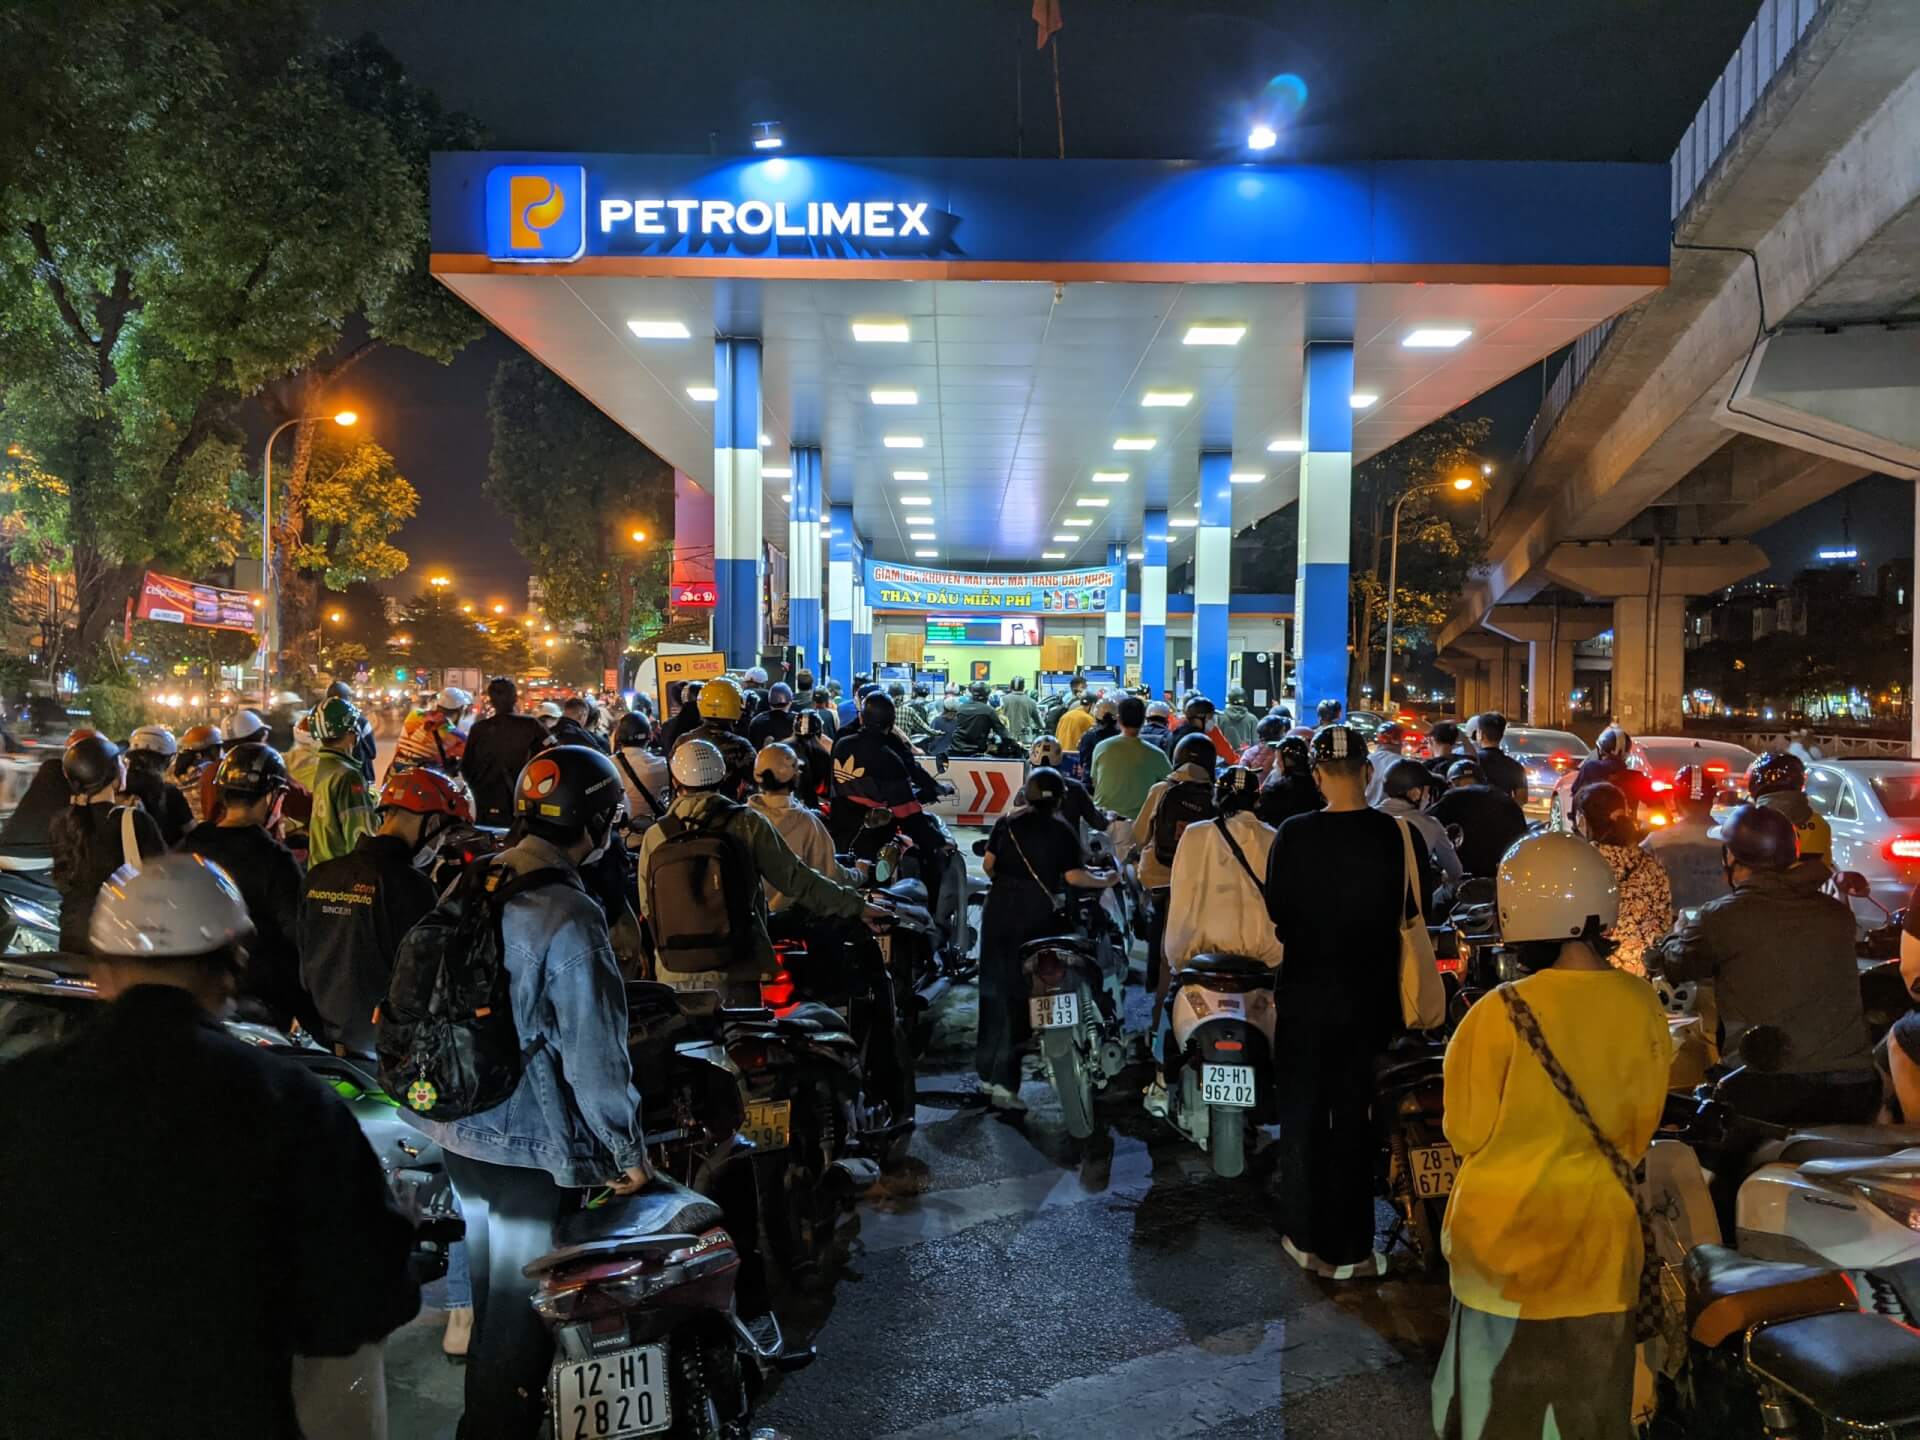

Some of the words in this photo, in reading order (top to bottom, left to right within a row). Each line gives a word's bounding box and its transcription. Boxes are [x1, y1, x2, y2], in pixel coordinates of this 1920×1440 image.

[599, 199, 930, 237] PETROLIMEX
[880, 590, 922, 603] THAY
[1005, 591, 1032, 607] PHÍ
[664, 661, 682, 672] be
[1209, 1067, 1248, 1084] 29-H1
[1205, 1085, 1253, 1103] 962.02
[1419, 1172, 1454, 1194] 673
[593, 1337, 625, 1348] HONDA
[574, 1352, 649, 1399] 12-H1
[573, 1391, 653, 1440] 2820
